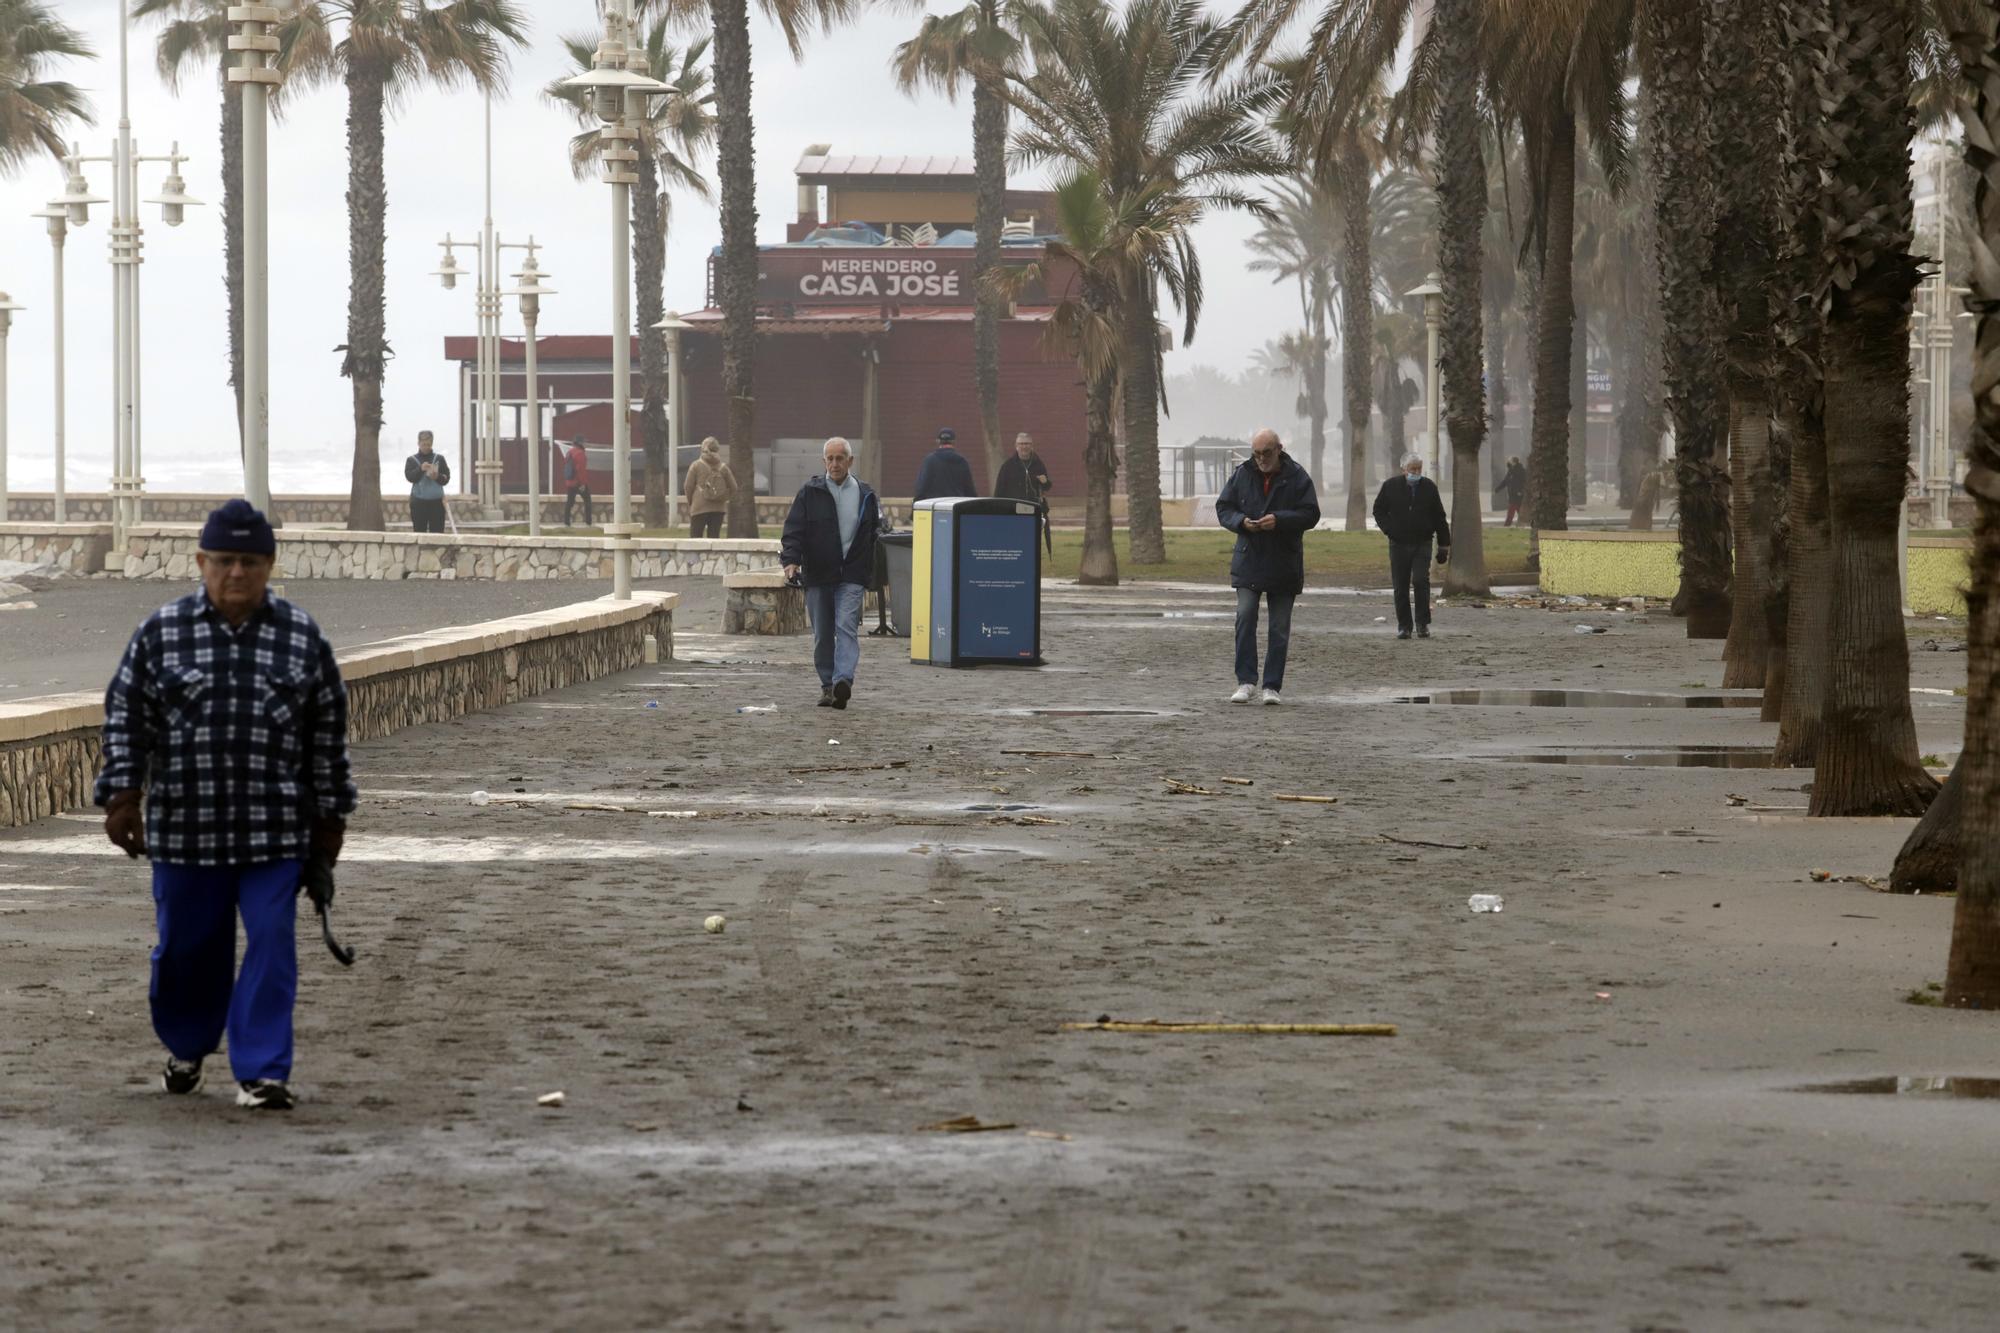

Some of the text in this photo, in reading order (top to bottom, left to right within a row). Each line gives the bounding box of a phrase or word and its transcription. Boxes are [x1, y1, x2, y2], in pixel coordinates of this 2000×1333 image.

[822, 259, 937, 273] MERENDERO
[799, 270, 960, 296] CASA JOSÉ
